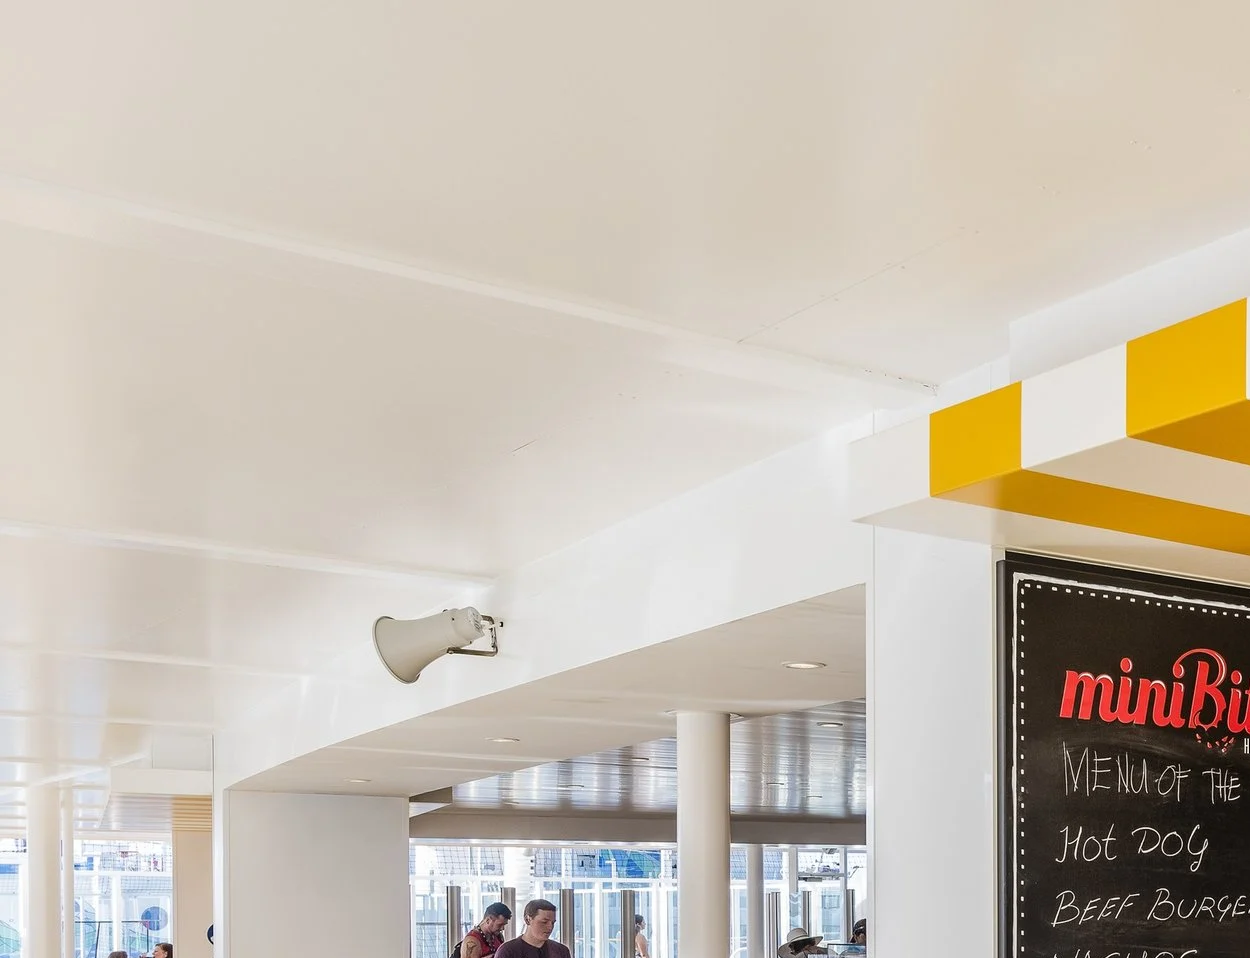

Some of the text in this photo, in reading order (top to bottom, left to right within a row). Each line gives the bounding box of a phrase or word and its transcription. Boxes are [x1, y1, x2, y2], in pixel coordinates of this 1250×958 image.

[1062, 741, 1149, 797] MENU
[1155, 763, 1191, 802] OF
[1202, 767, 1241, 804] THE
[1131, 823, 1209, 872] DOG
[1051, 890, 1140, 927] BEEF
